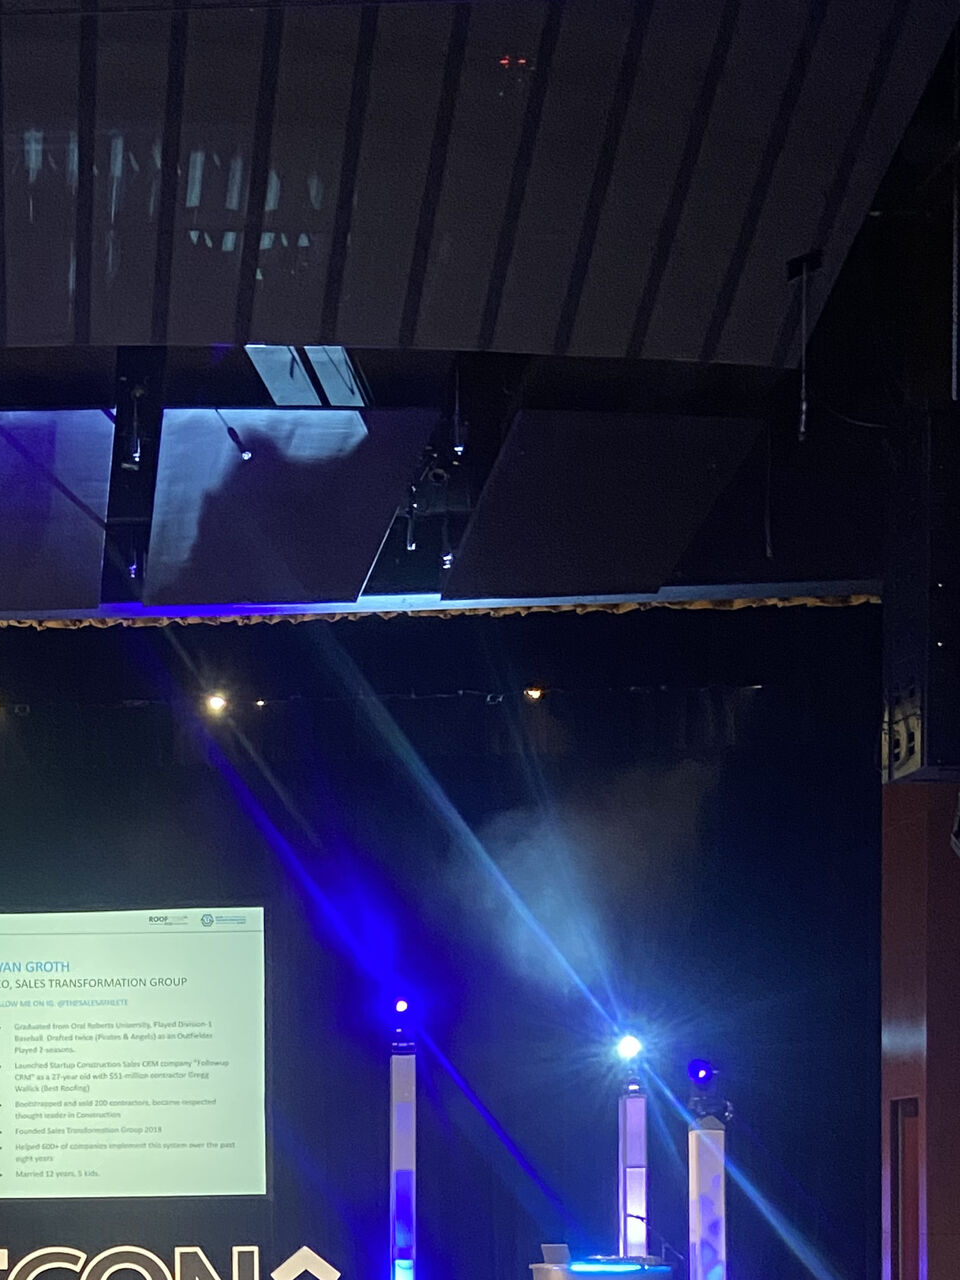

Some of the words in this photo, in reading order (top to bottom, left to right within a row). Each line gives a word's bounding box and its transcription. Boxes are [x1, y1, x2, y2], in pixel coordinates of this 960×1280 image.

[25, 961, 70, 973] GROTH
[15, 979, 46, 989] SALES
[48, 978, 147, 988] TRANSFORMATION
[149, 977, 188, 987] GROUP
[95, 1034, 121, 1042] (Pirates
[130, 1033, 156, 1041] Angels)
[14, 1047, 38, 1055] Played
[50, 1062, 75, 1070] Startup
[14, 1073, 35, 1081] CRM"
[188, 1071, 210, 1080] Gregg
[41, 1085, 59, 1093] (Best
[60, 1085, 90, 1093] Roofing)
[14, 1100, 62, 1109] Bootstrapped
[94, 1099, 108, 1107] 200
[182, 1098, 217, 1106] respected
[14, 1112, 42, 1120] thought
[76, 1111, 122, 1119] Construction
[15, 1127, 46, 1135] Founded
[120, 1126, 143, 1135] Group
[15, 1143, 40, 1151] Helped
[69, 1143, 107, 1151] companies
[108, 1142, 147, 1150] implement
[162, 1142, 187, 1150] system
[220, 1142, 236, 1150] past
[15, 1155, 33, 1163] eight
[15, 1170, 44, 1178] Married
